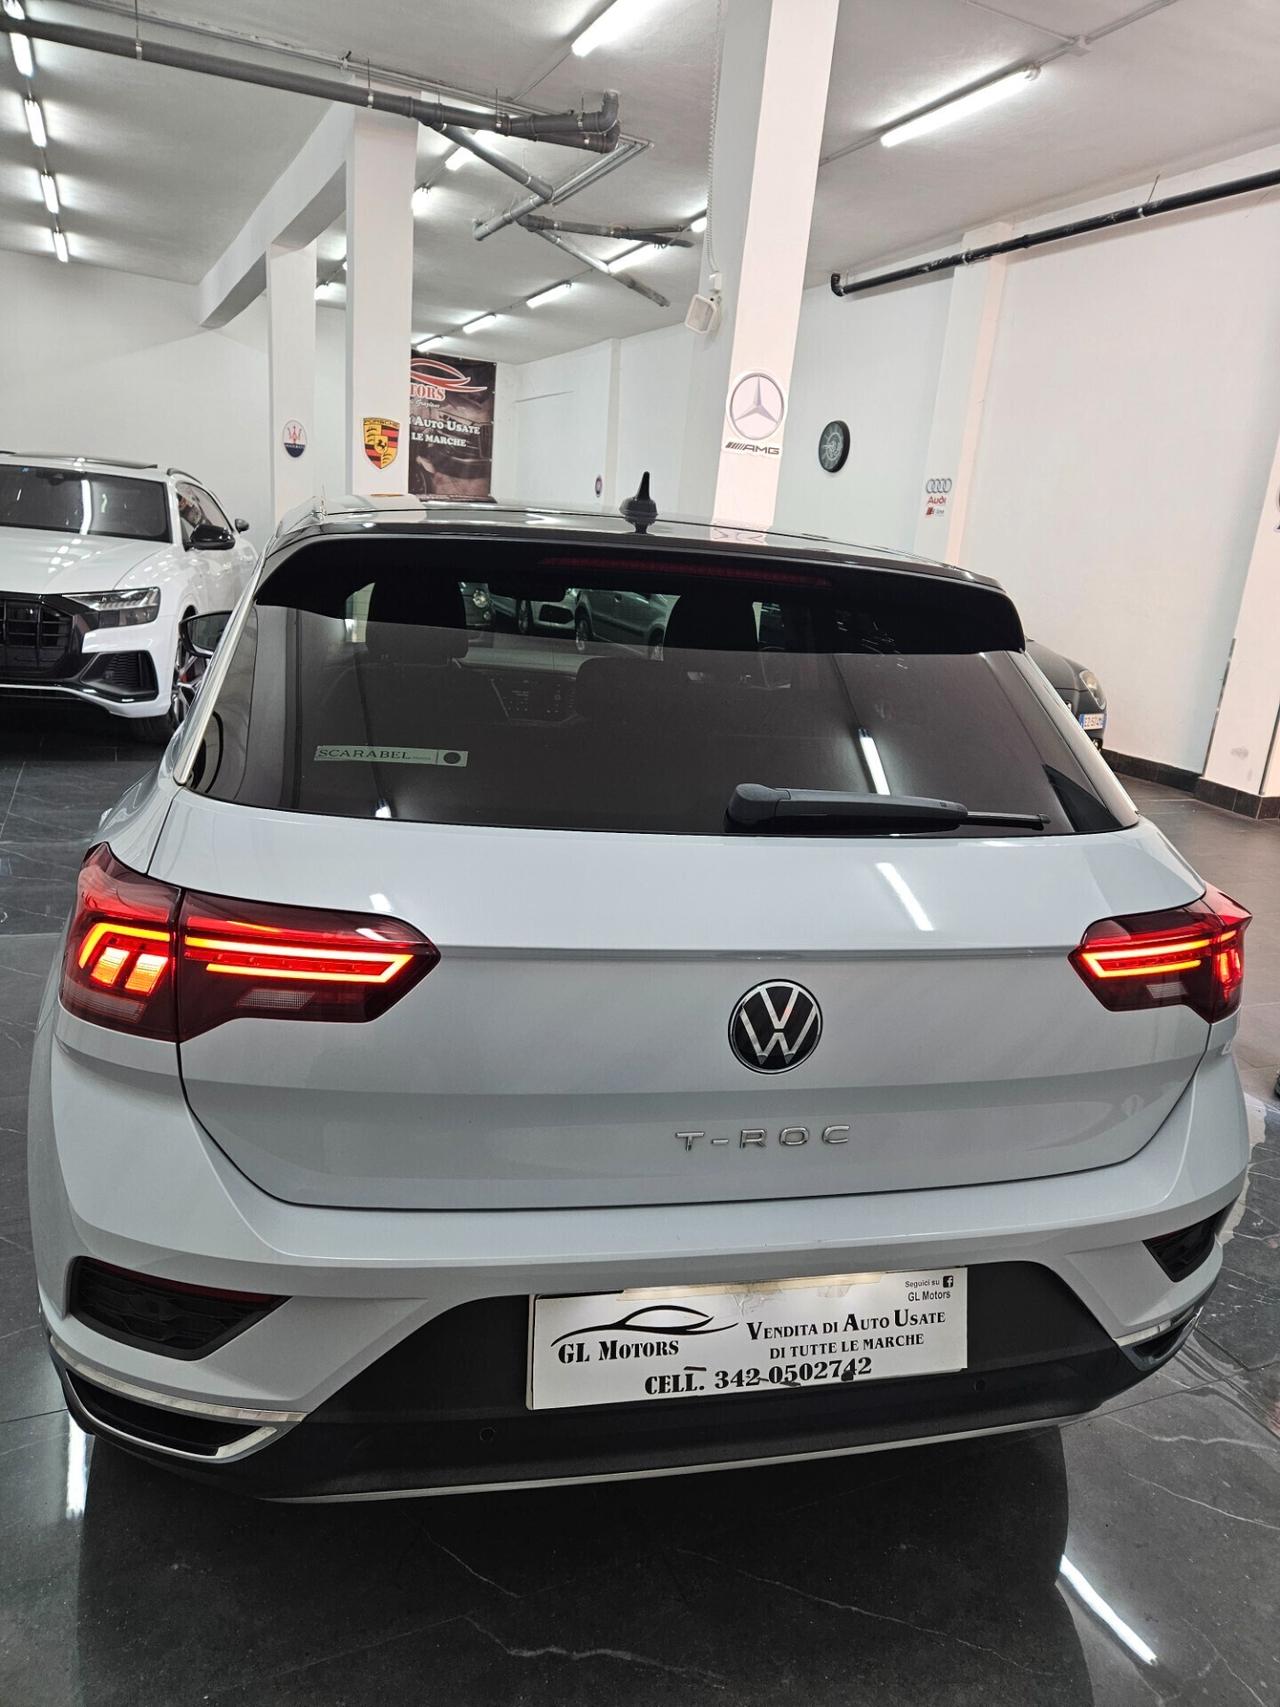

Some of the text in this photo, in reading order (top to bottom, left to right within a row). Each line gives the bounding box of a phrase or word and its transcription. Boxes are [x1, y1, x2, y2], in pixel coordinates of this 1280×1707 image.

[410, 383, 445, 401] TORS
[415, 415, 480, 434] AUTO USATE
[411, 432, 466, 447] LE MARCHE
[743, 444, 780, 455] AMG
[928, 496, 946, 505] Audi
[675, 1125, 850, 1151] T-ROC
[905, 1280, 930, 1288] Seguici
[908, 1289, 951, 1302] GL Motors
[747, 1309, 946, 1340] VENDITA DI AUTO USATE
[558, 1340, 679, 1364] GL MOTORS
[770, 1333, 924, 1359] DI TUTTE LE MARCHE
[644, 1373, 705, 1395] CELL.
